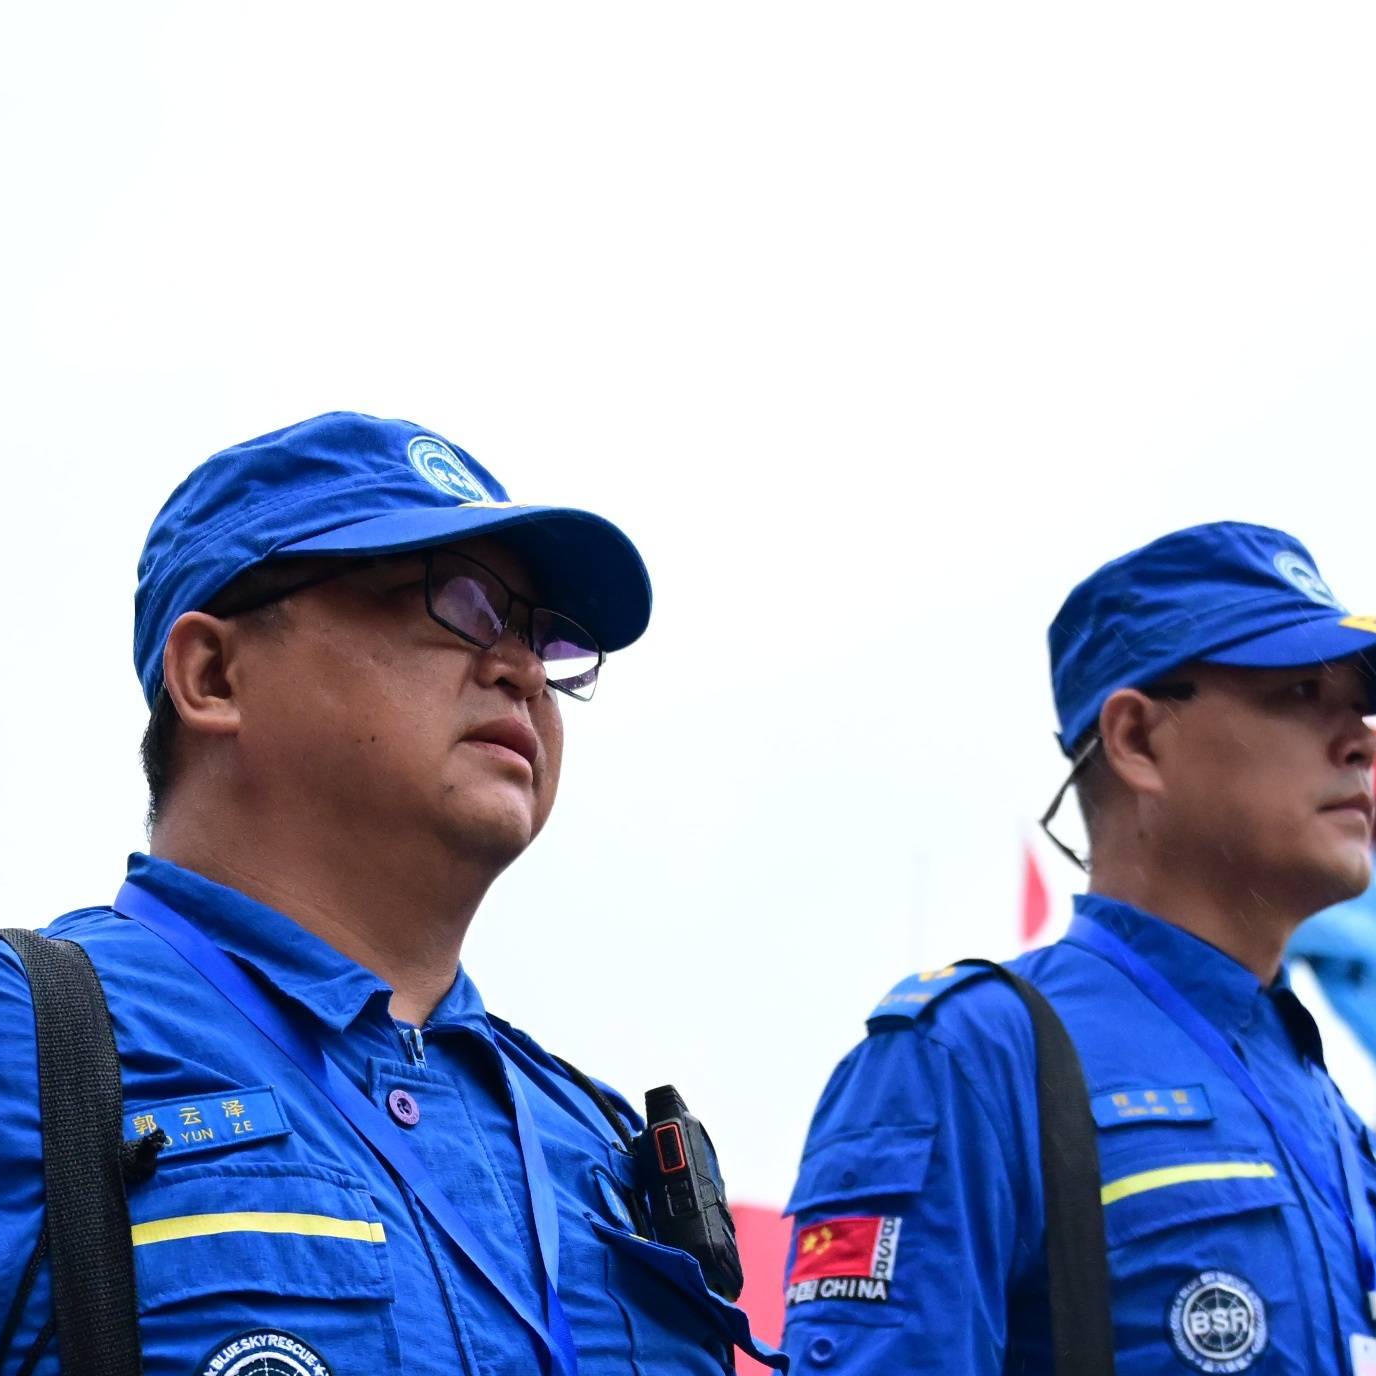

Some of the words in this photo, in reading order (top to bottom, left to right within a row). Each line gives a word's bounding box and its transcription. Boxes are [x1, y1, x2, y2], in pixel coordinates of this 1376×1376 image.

[132, 1099, 245, 1135] 郭云泽
[181, 1127, 214, 1144] YUN
[232, 1120, 254, 1134] ZE
[820, 1278, 887, 1301] CHINA
[1190, 1307, 1249, 1336] BSR
